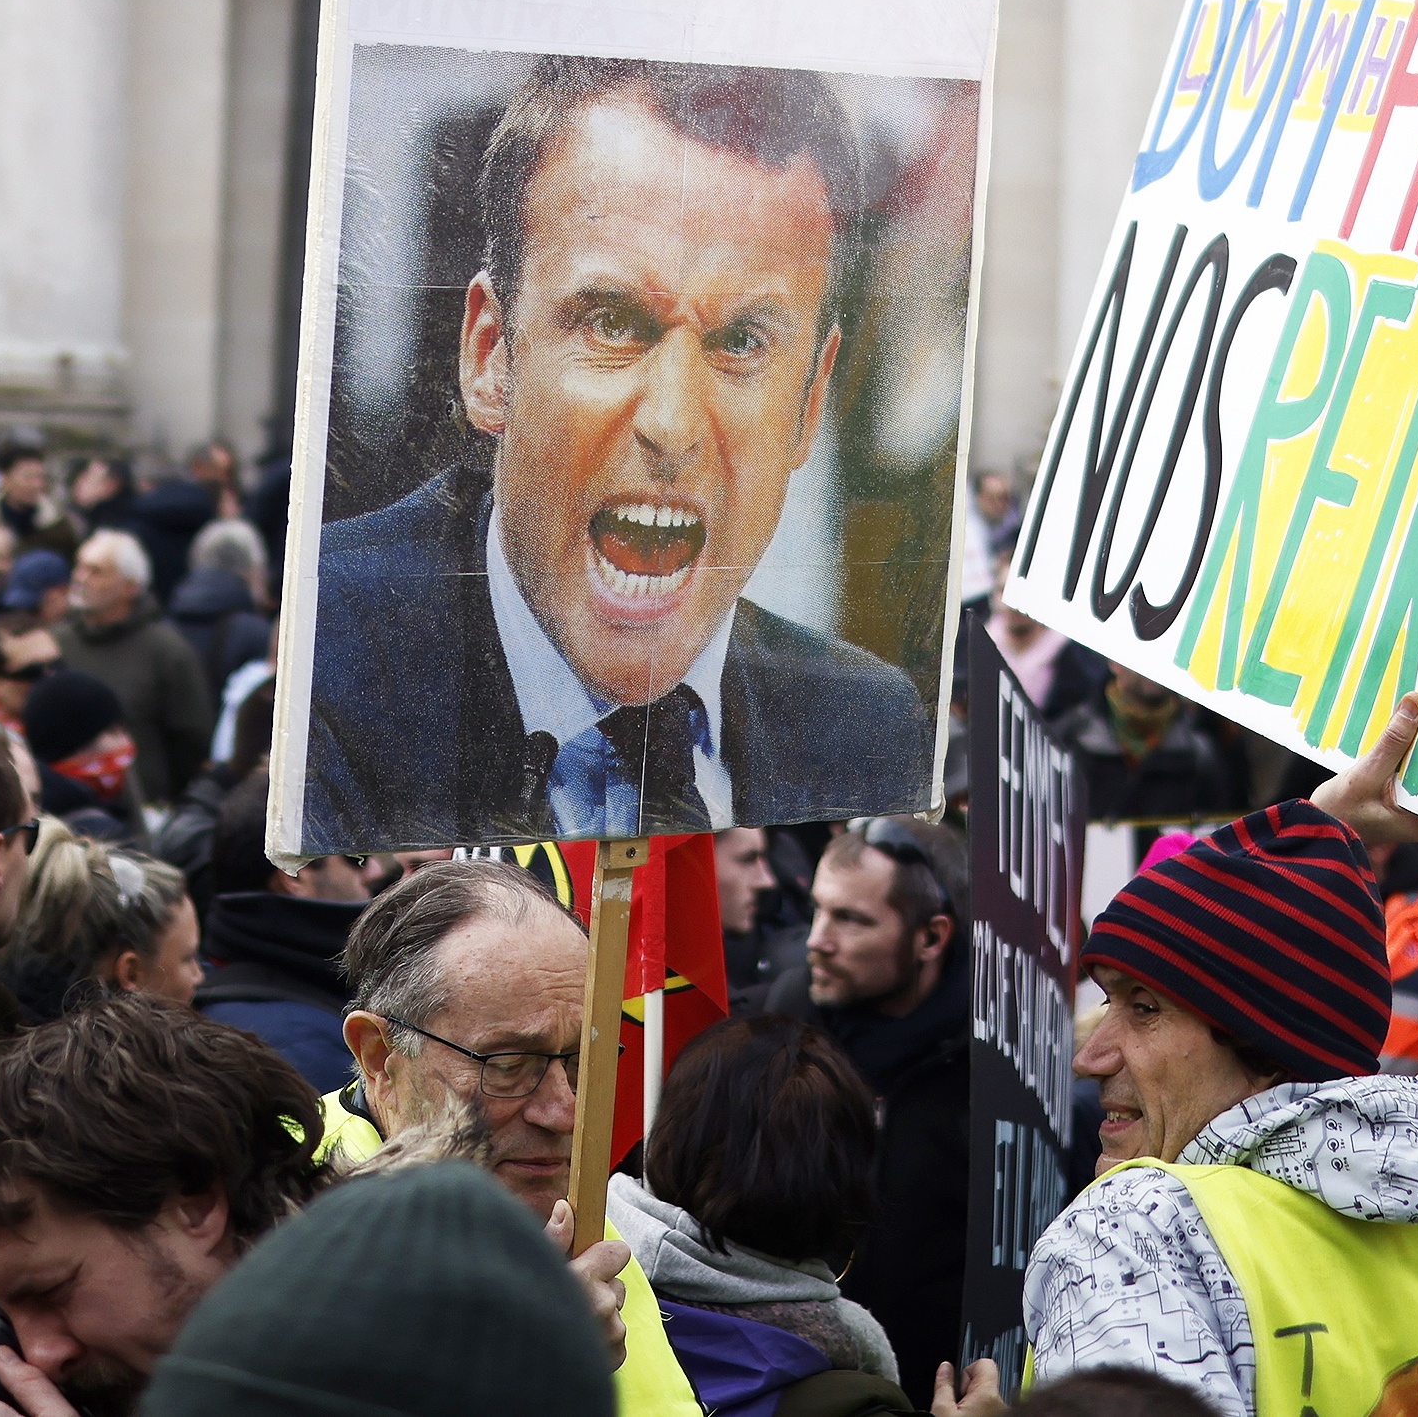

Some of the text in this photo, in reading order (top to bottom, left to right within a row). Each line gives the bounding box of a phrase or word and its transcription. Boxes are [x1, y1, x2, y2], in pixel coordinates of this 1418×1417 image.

[1017, 221, 1298, 642] NOS
[998, 668, 1074, 967] FEMMES
[996, 935, 1011, 1057] DE
